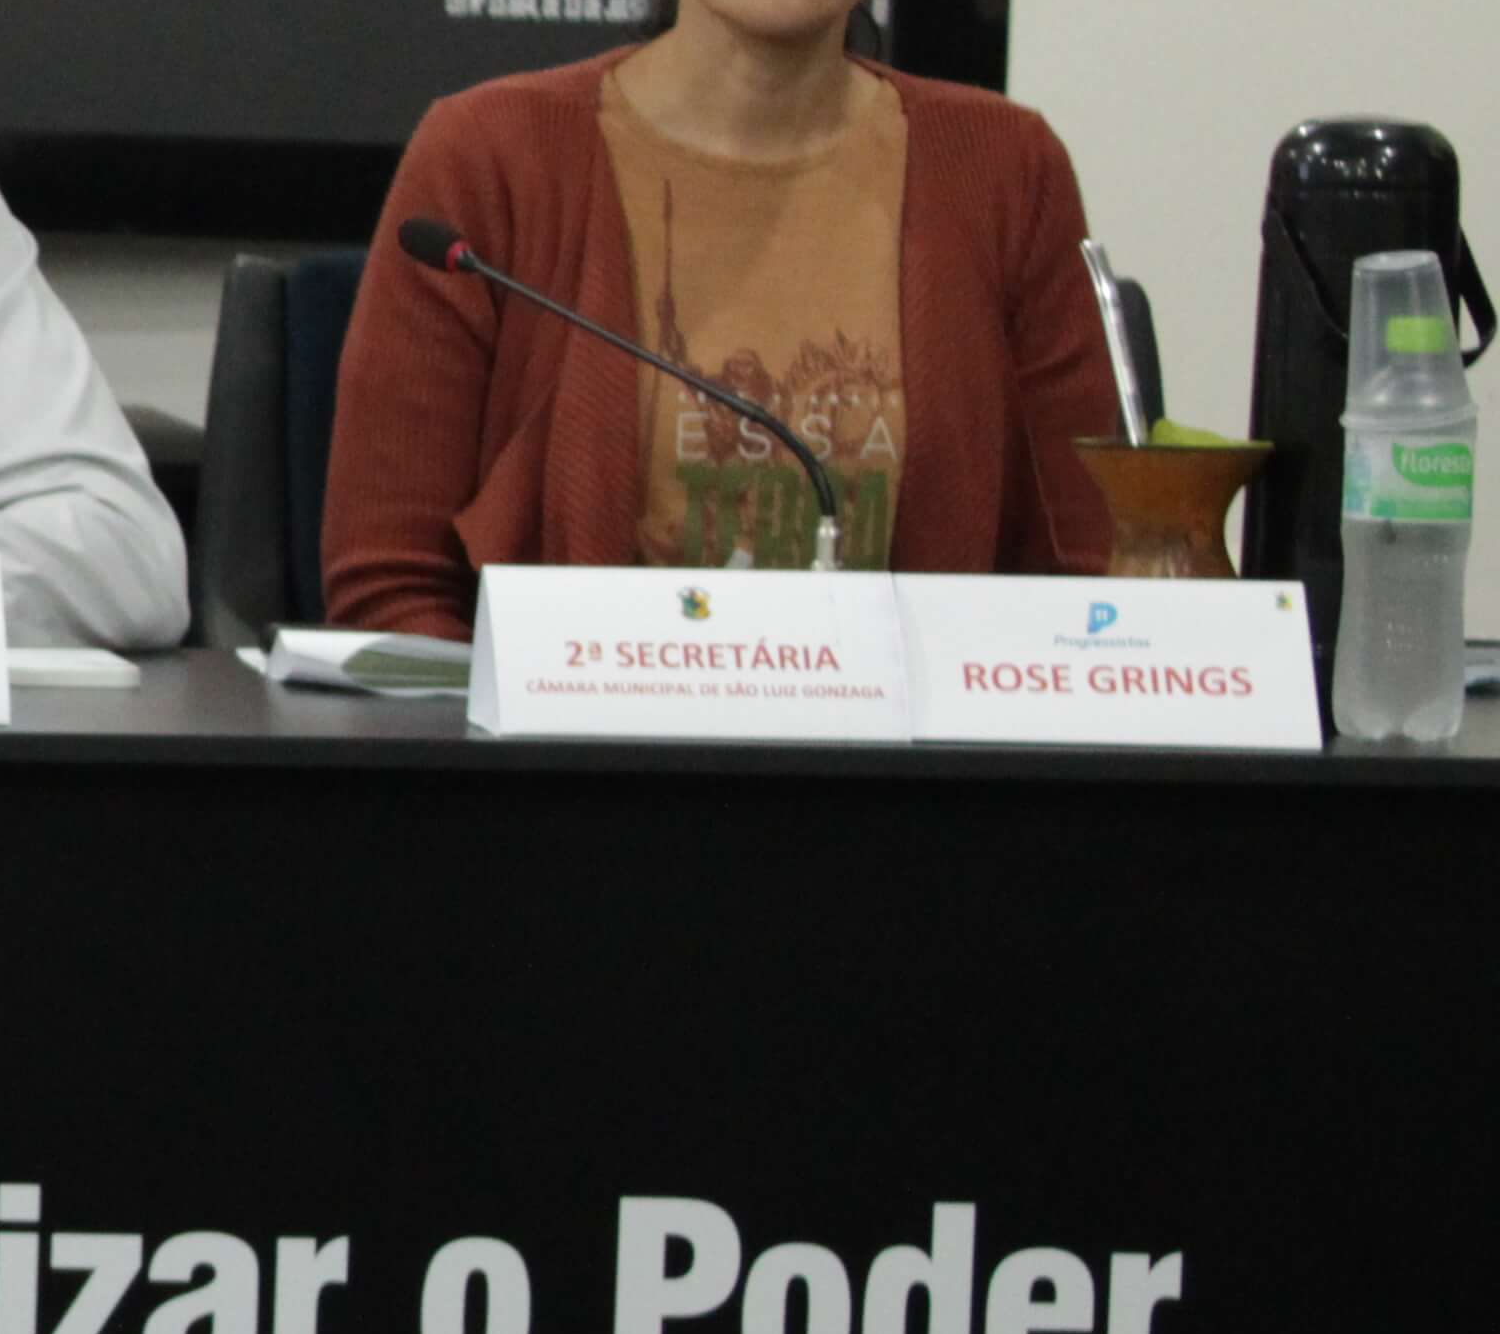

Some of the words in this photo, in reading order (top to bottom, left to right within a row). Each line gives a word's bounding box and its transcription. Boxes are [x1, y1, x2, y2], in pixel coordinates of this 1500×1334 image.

[675, 411, 897, 460] ESSA
[615, 637, 841, 673] SECRETÁRIA
[961, 661, 1073, 694] ROSE
[1086, 664, 1254, 698] GRINGS
